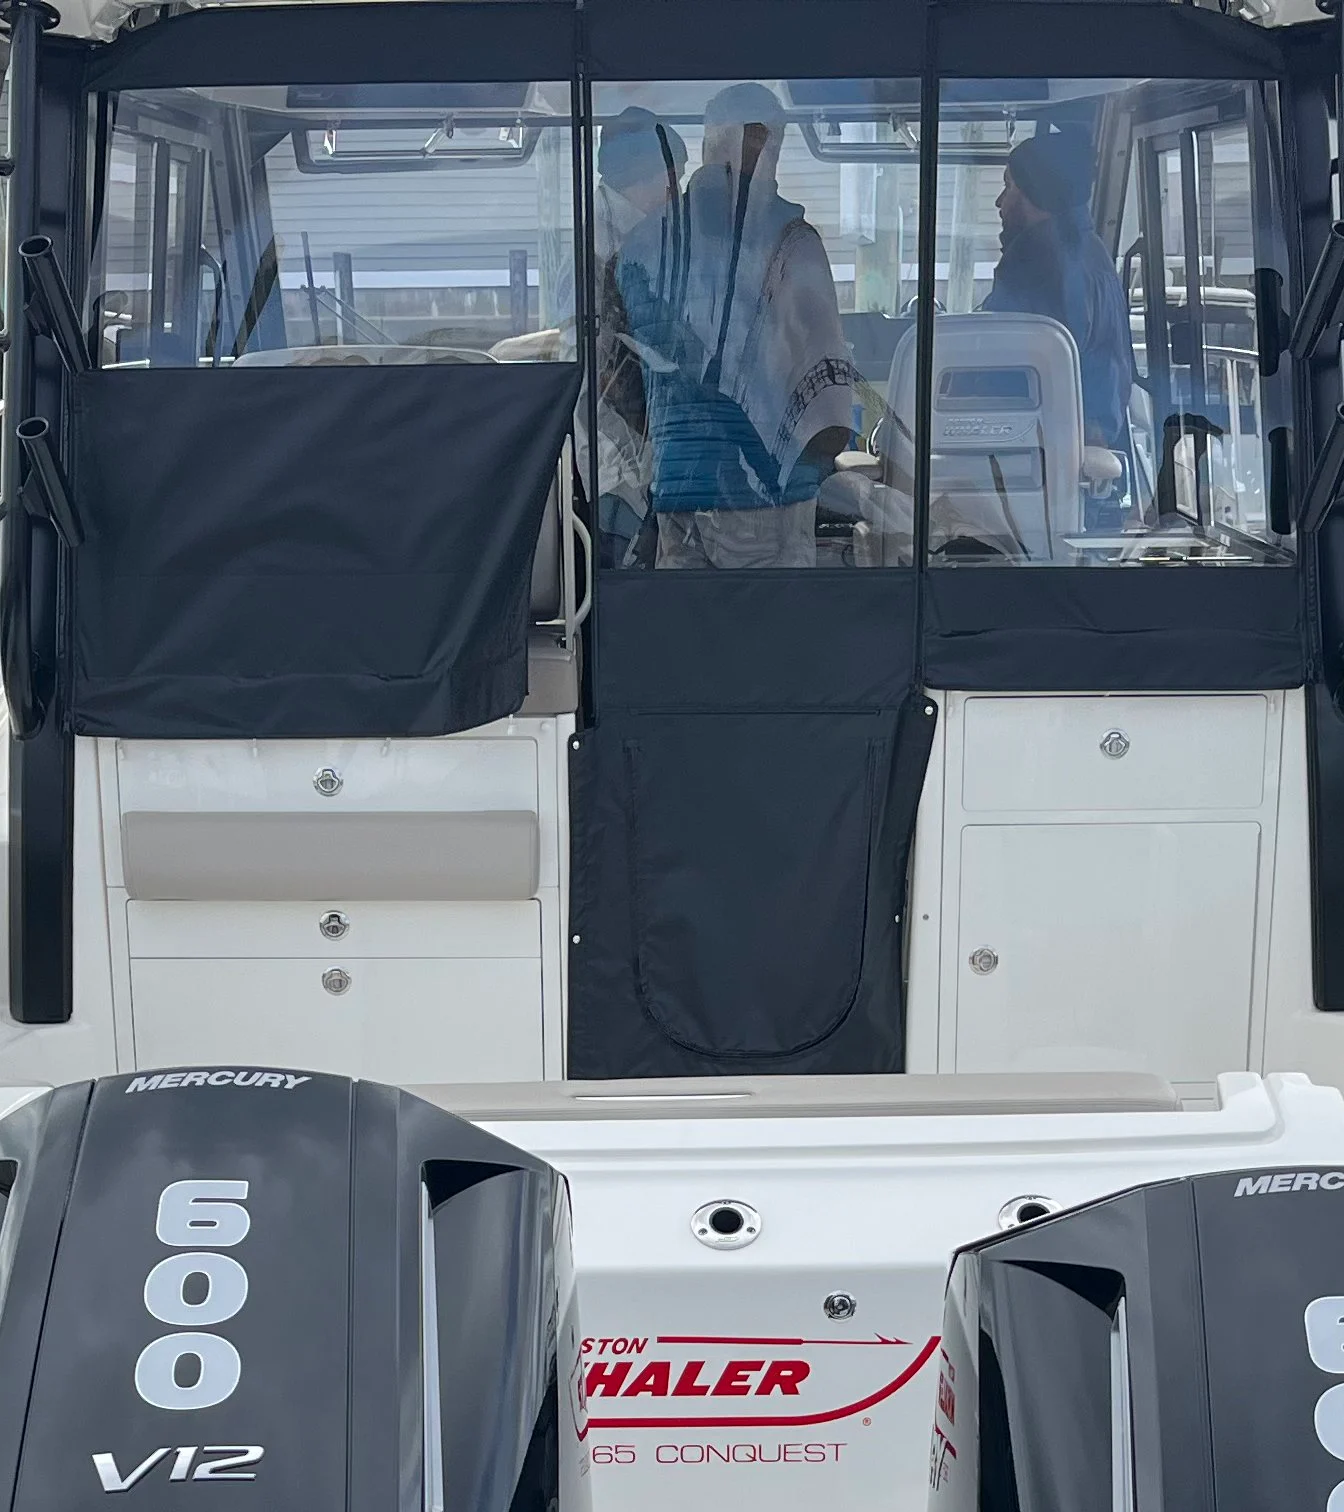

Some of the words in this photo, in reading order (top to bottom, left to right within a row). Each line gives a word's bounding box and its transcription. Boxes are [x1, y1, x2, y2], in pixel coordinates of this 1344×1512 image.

[125, 1071, 312, 1094] MERCURY
[134, 1179, 251, 1411] 600
[581, 1337, 648, 1355] STON
[591, 1445, 636, 1464] 65
[655, 1443, 848, 1464] CONQUEST
[91, 1445, 265, 1493] V12
